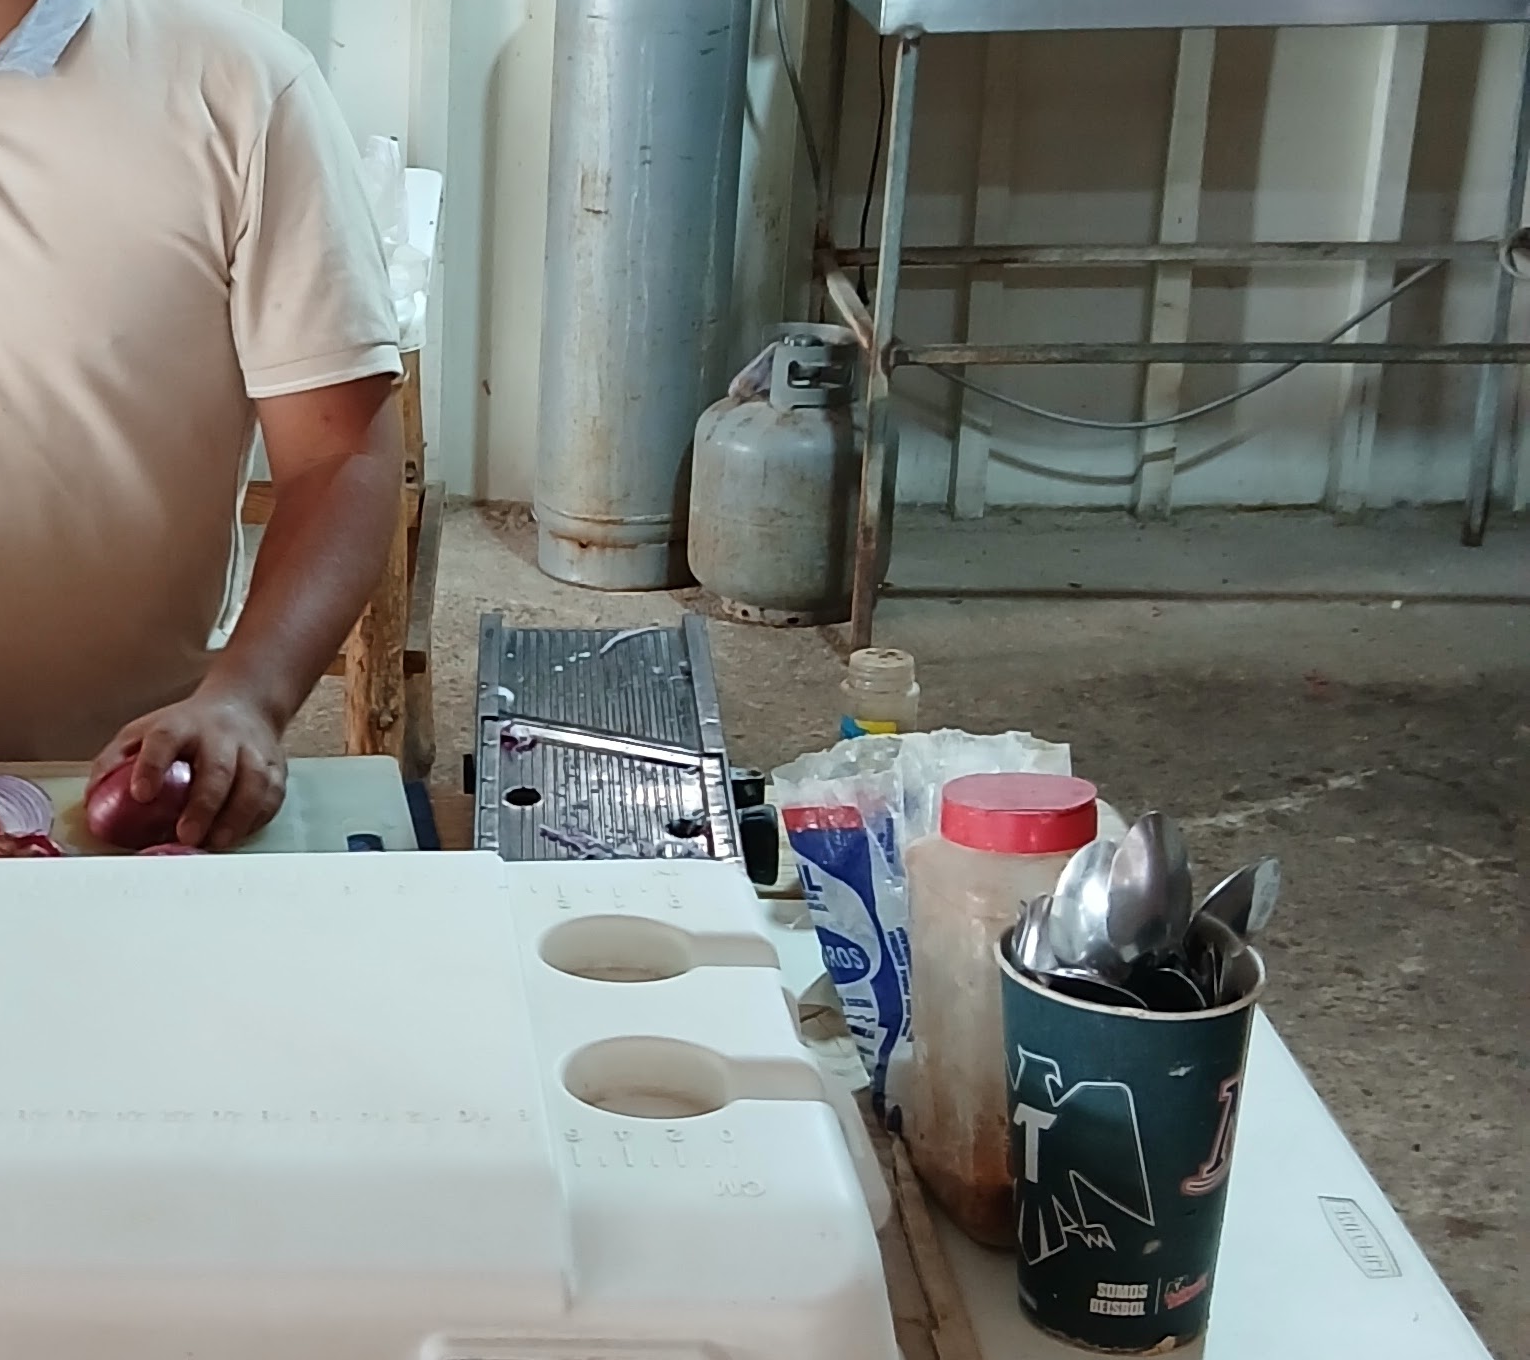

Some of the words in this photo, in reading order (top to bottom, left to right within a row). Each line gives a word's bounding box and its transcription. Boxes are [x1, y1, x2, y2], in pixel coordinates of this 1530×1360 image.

[823, 945, 865, 970] ROS
[1013, 1101, 1058, 1184] T
[1096, 1282, 1149, 1299] SOMOS
